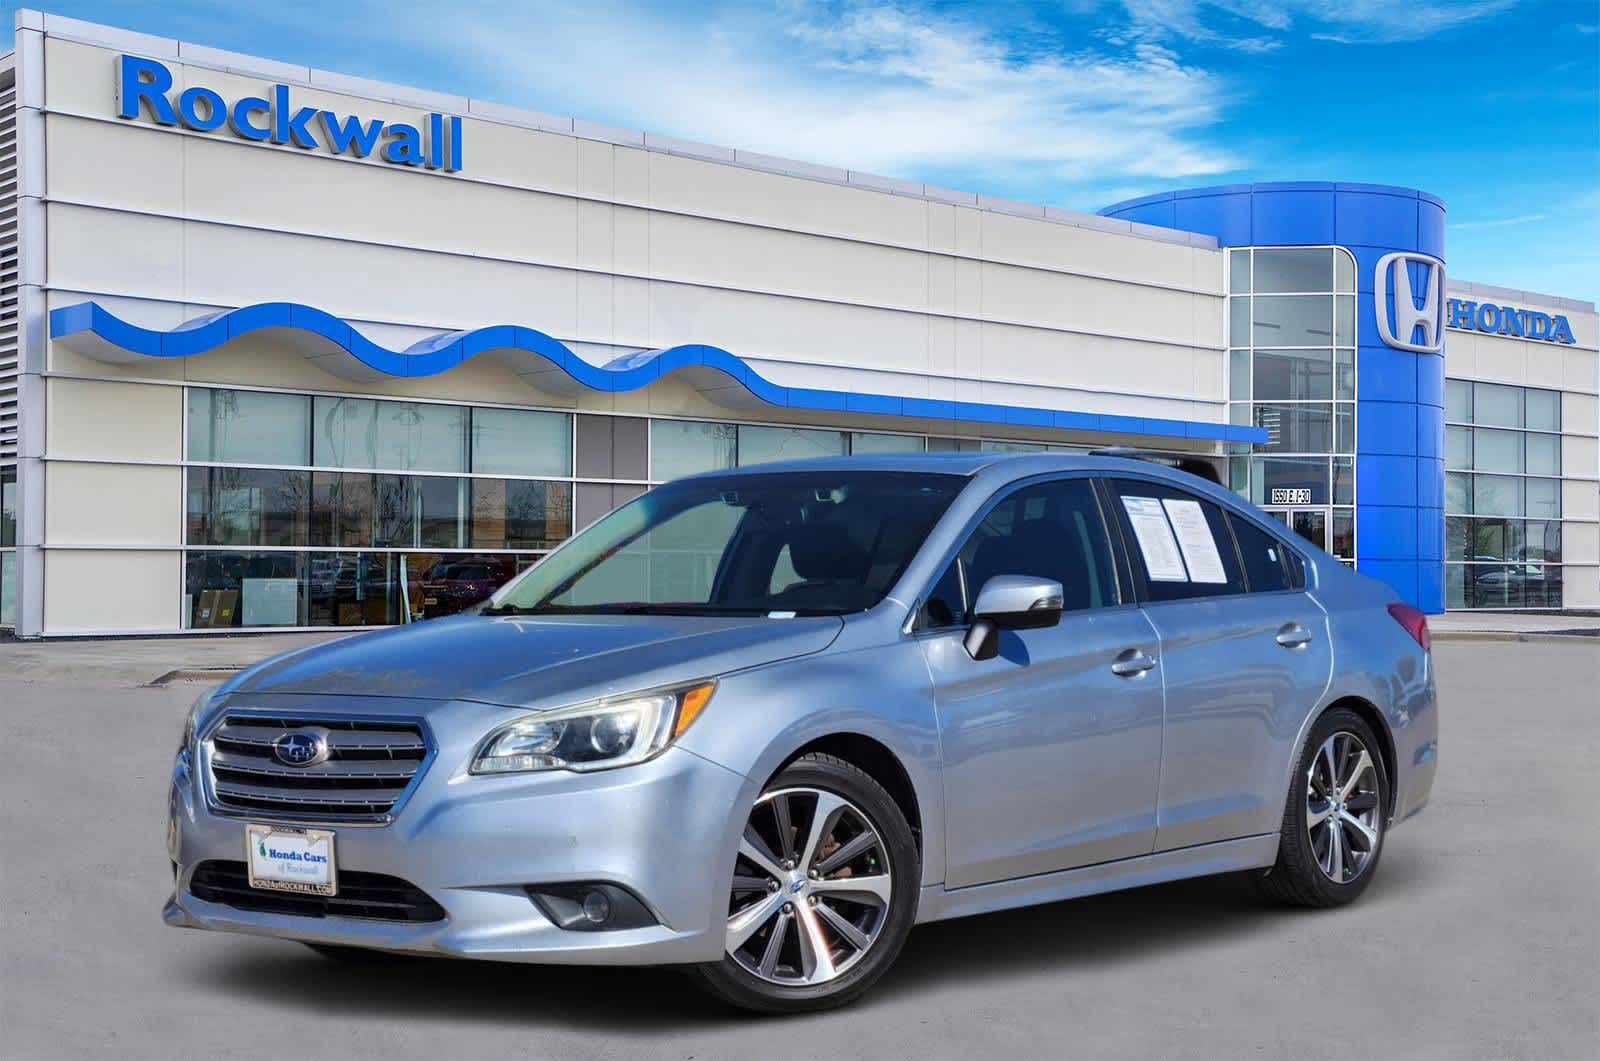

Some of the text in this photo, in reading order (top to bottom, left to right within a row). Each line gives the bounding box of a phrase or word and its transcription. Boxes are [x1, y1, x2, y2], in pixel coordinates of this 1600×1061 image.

[118, 54, 463, 172] Rockwall
[1446, 299, 1577, 344] HONDA
[1273, 490, 1288, 503] 1550
[269, 848, 327, 863] Honda Cars
